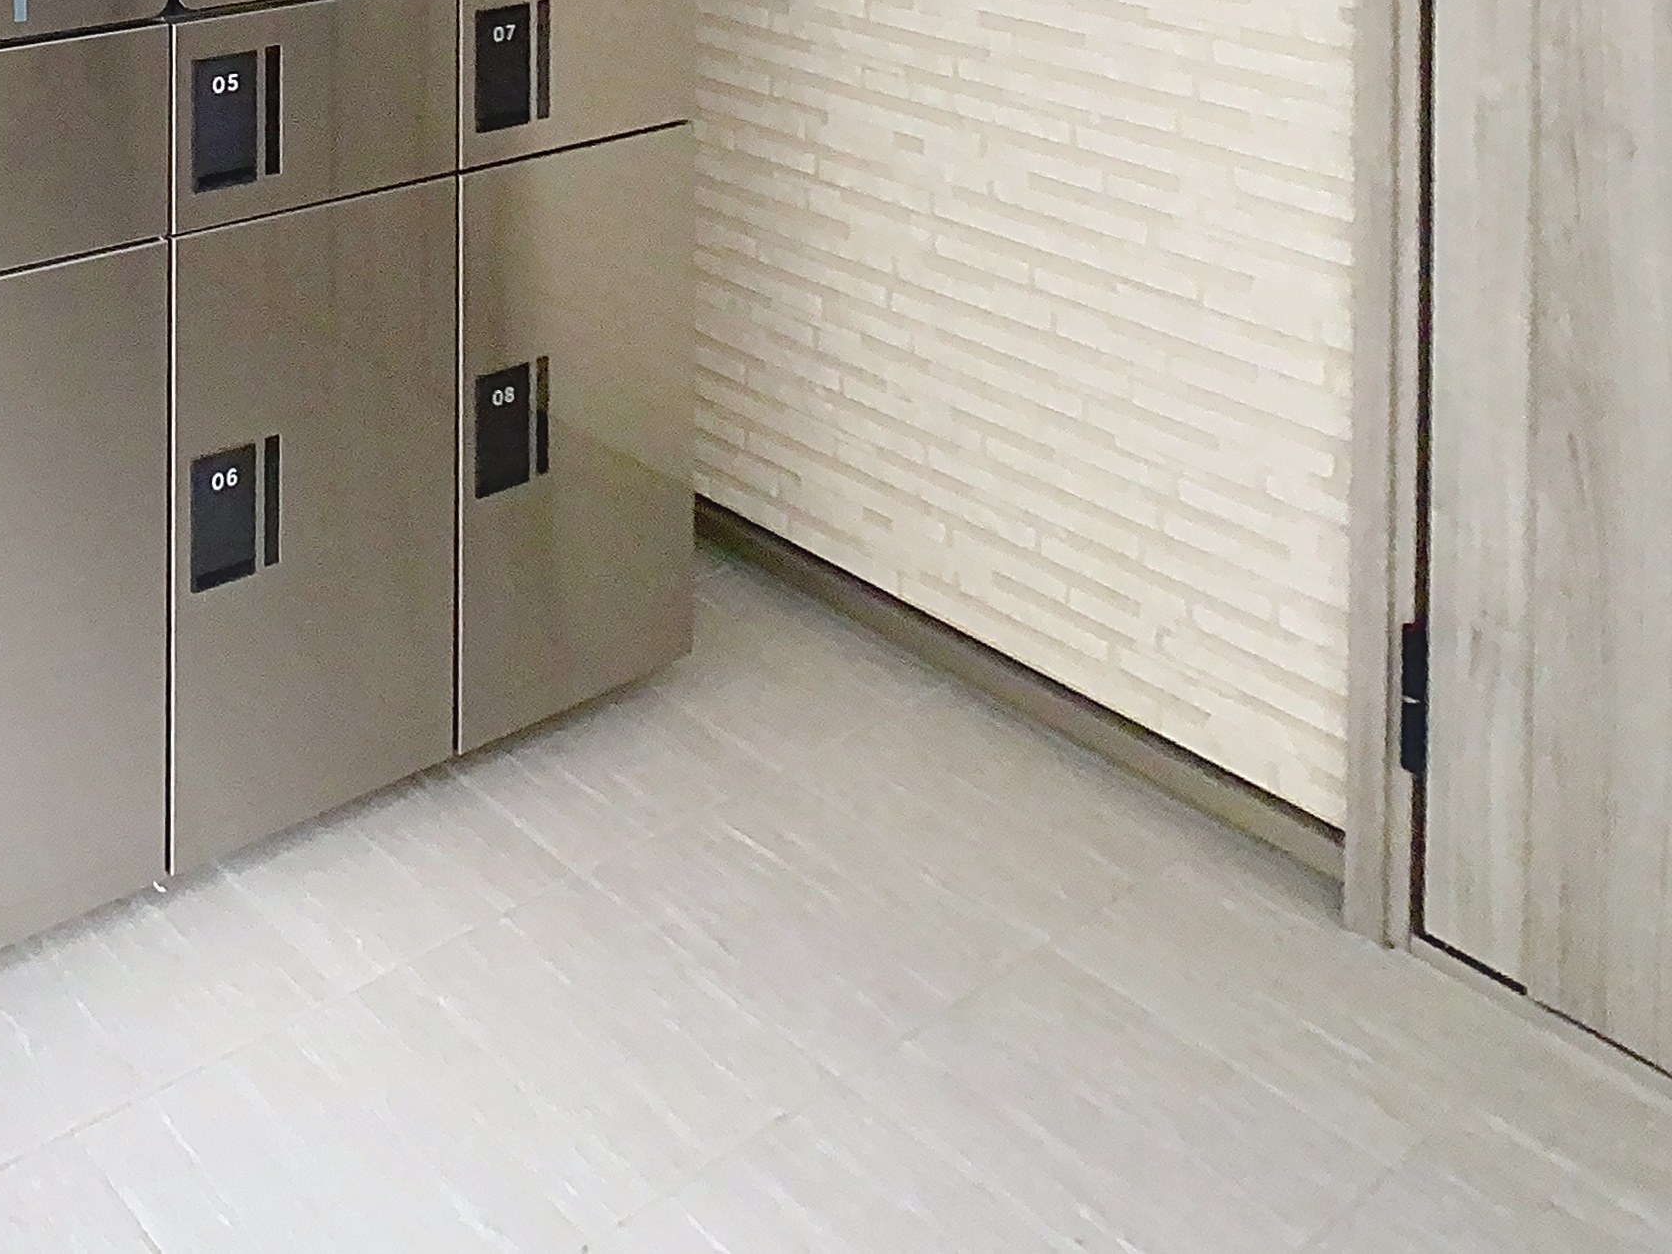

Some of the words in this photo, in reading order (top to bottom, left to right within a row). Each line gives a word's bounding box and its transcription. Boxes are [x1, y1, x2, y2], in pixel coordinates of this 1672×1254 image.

[493, 24, 517, 43] 07
[211, 72, 241, 95] 05
[491, 384, 516, 407] 08
[210, 468, 240, 493] 06
